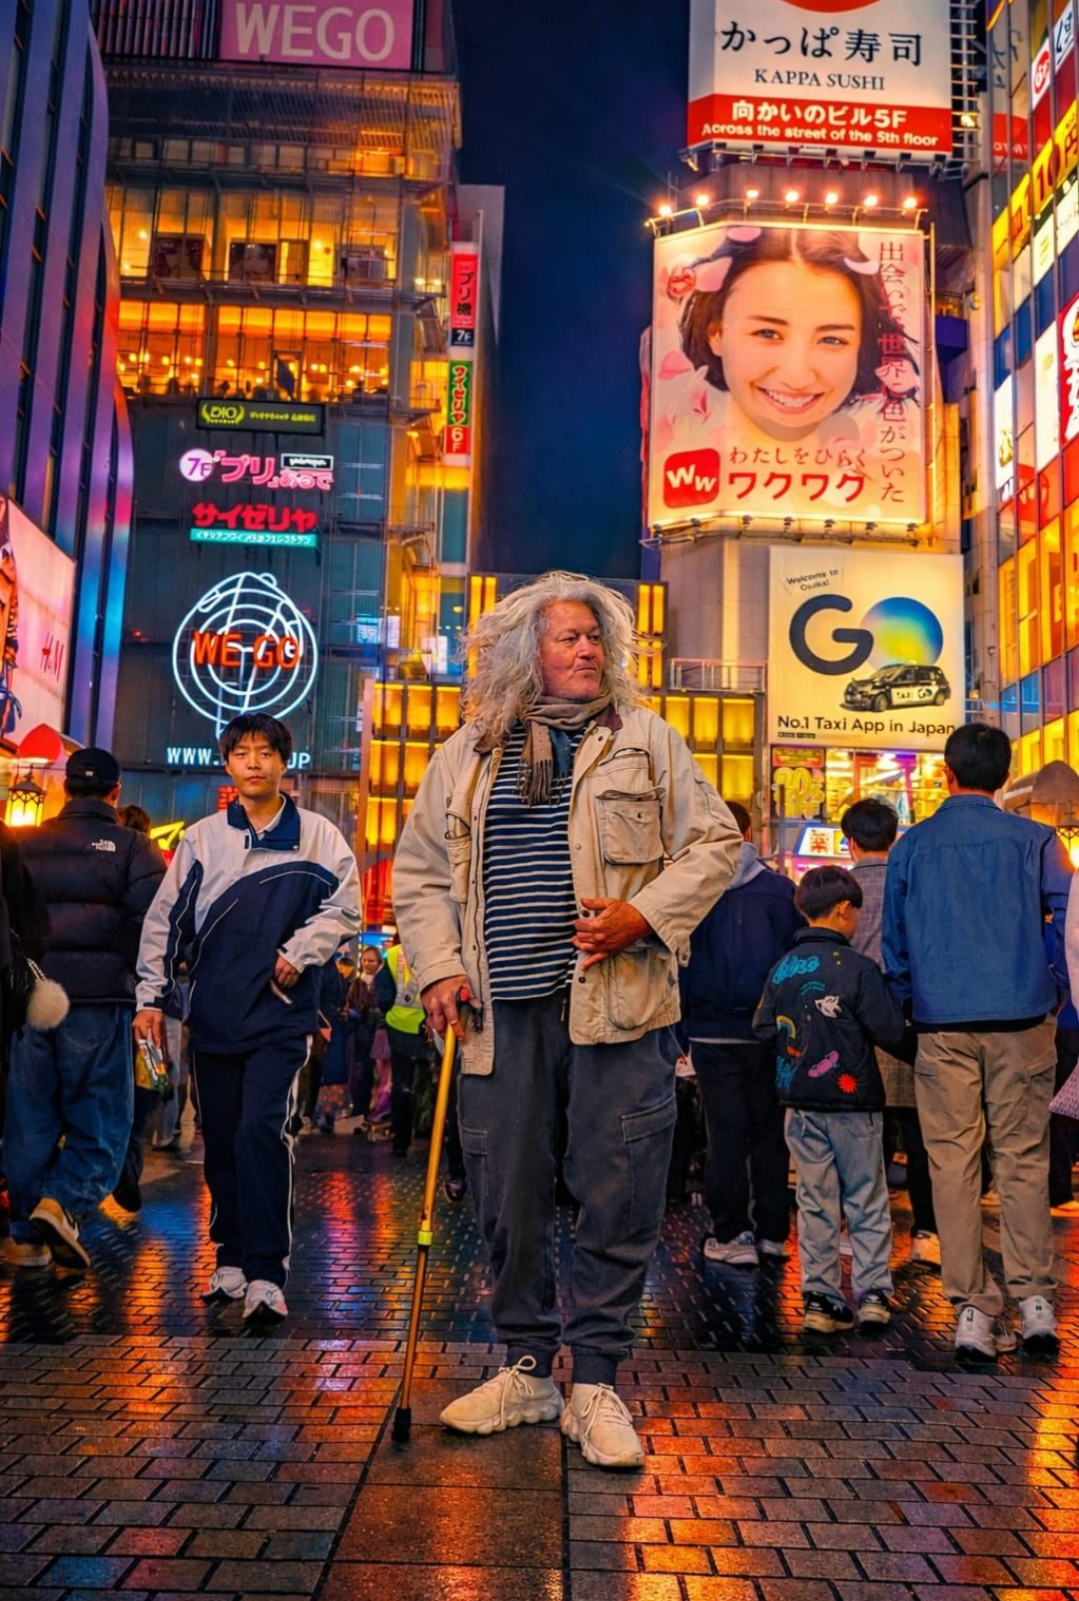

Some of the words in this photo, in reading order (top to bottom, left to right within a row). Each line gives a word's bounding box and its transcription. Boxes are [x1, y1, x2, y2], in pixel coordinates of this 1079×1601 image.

[236, 2, 395, 61] WEGO
[720, 20, 922, 66] かっぱ寿司
[754, 68, 821, 88] KAPPA
[827, 73, 885, 91] SUSHI
[731, 99, 908, 127] 向かいのビル5F
[702, 122, 753, 138] Across
[757, 123, 781, 138] the
[785, 126, 827, 141] street
[831, 126, 846, 141] of
[849, 127, 873, 143] the
[877, 129, 900, 144] 5th
[903, 131, 938, 147] floor
[456, 329, 472, 342] 7F
[451, 427, 464, 453] 6F
[187, 457, 213, 477] 7F
[729, 446, 867, 468] わたしをひらく
[728, 471, 866, 503] ワクワク
[191, 502, 318, 533] サイゼリヤ
[777, 716, 809, 730] No.1
[814, 716, 847, 731] Taxi
[852, 719, 885, 734] App
[889, 720, 904, 733] in
[908, 721, 956, 737] Japan
